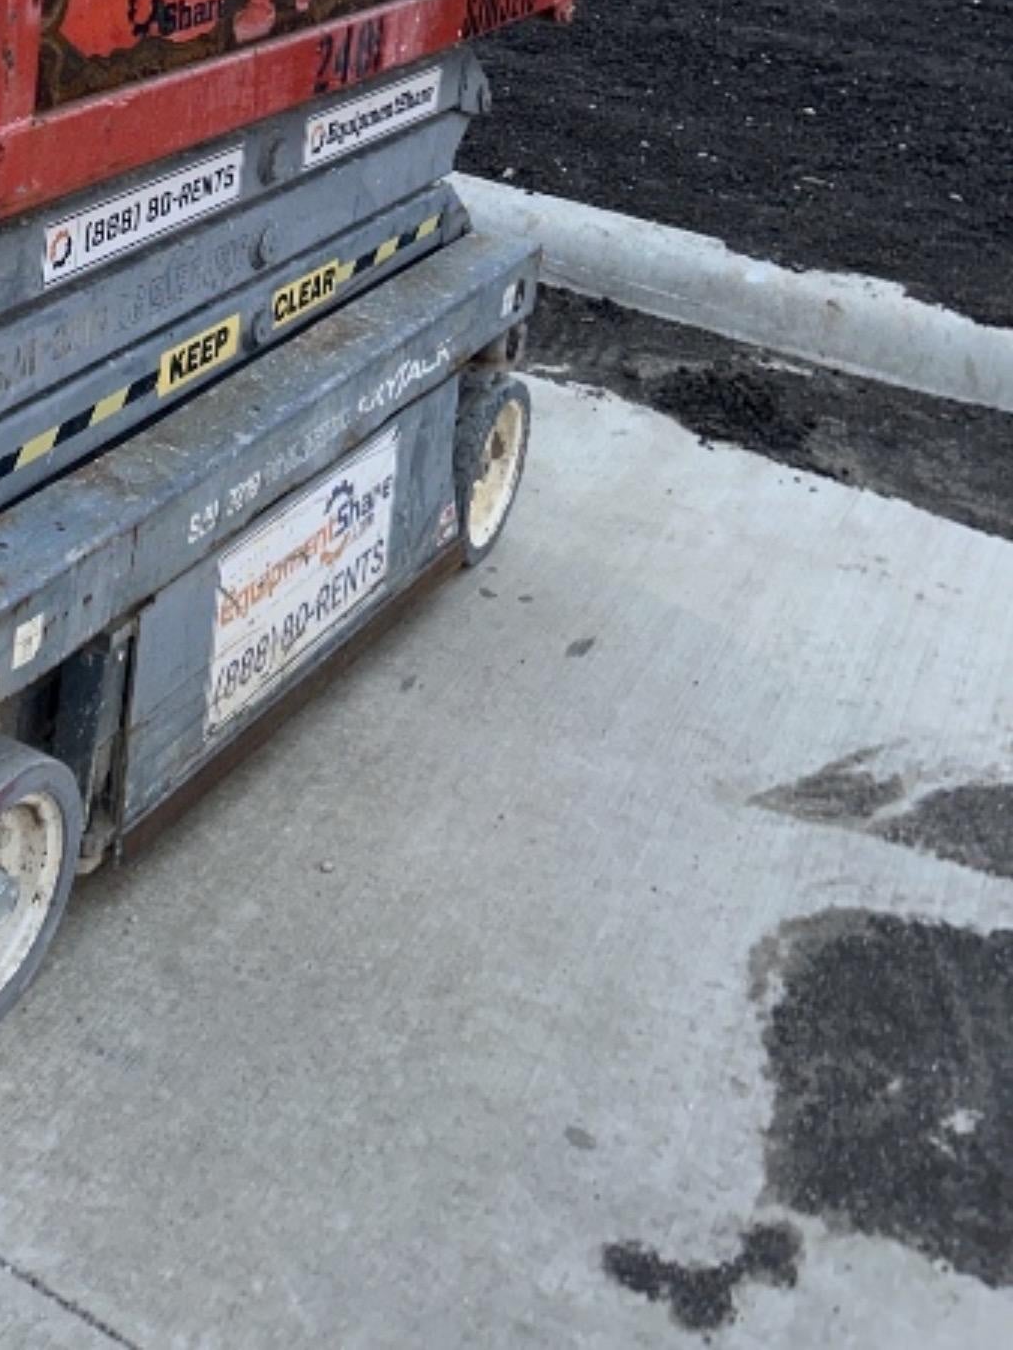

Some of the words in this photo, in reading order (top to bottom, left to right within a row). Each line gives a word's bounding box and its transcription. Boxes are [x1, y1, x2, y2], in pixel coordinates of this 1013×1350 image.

[84, 202, 142, 253] (888)
[146, 164, 237, 223] 80-RENTS
[168, 326, 229, 385] KEEP
[273, 266, 336, 322] CLEAR
[282, 538, 385, 654] 80-RENTS
